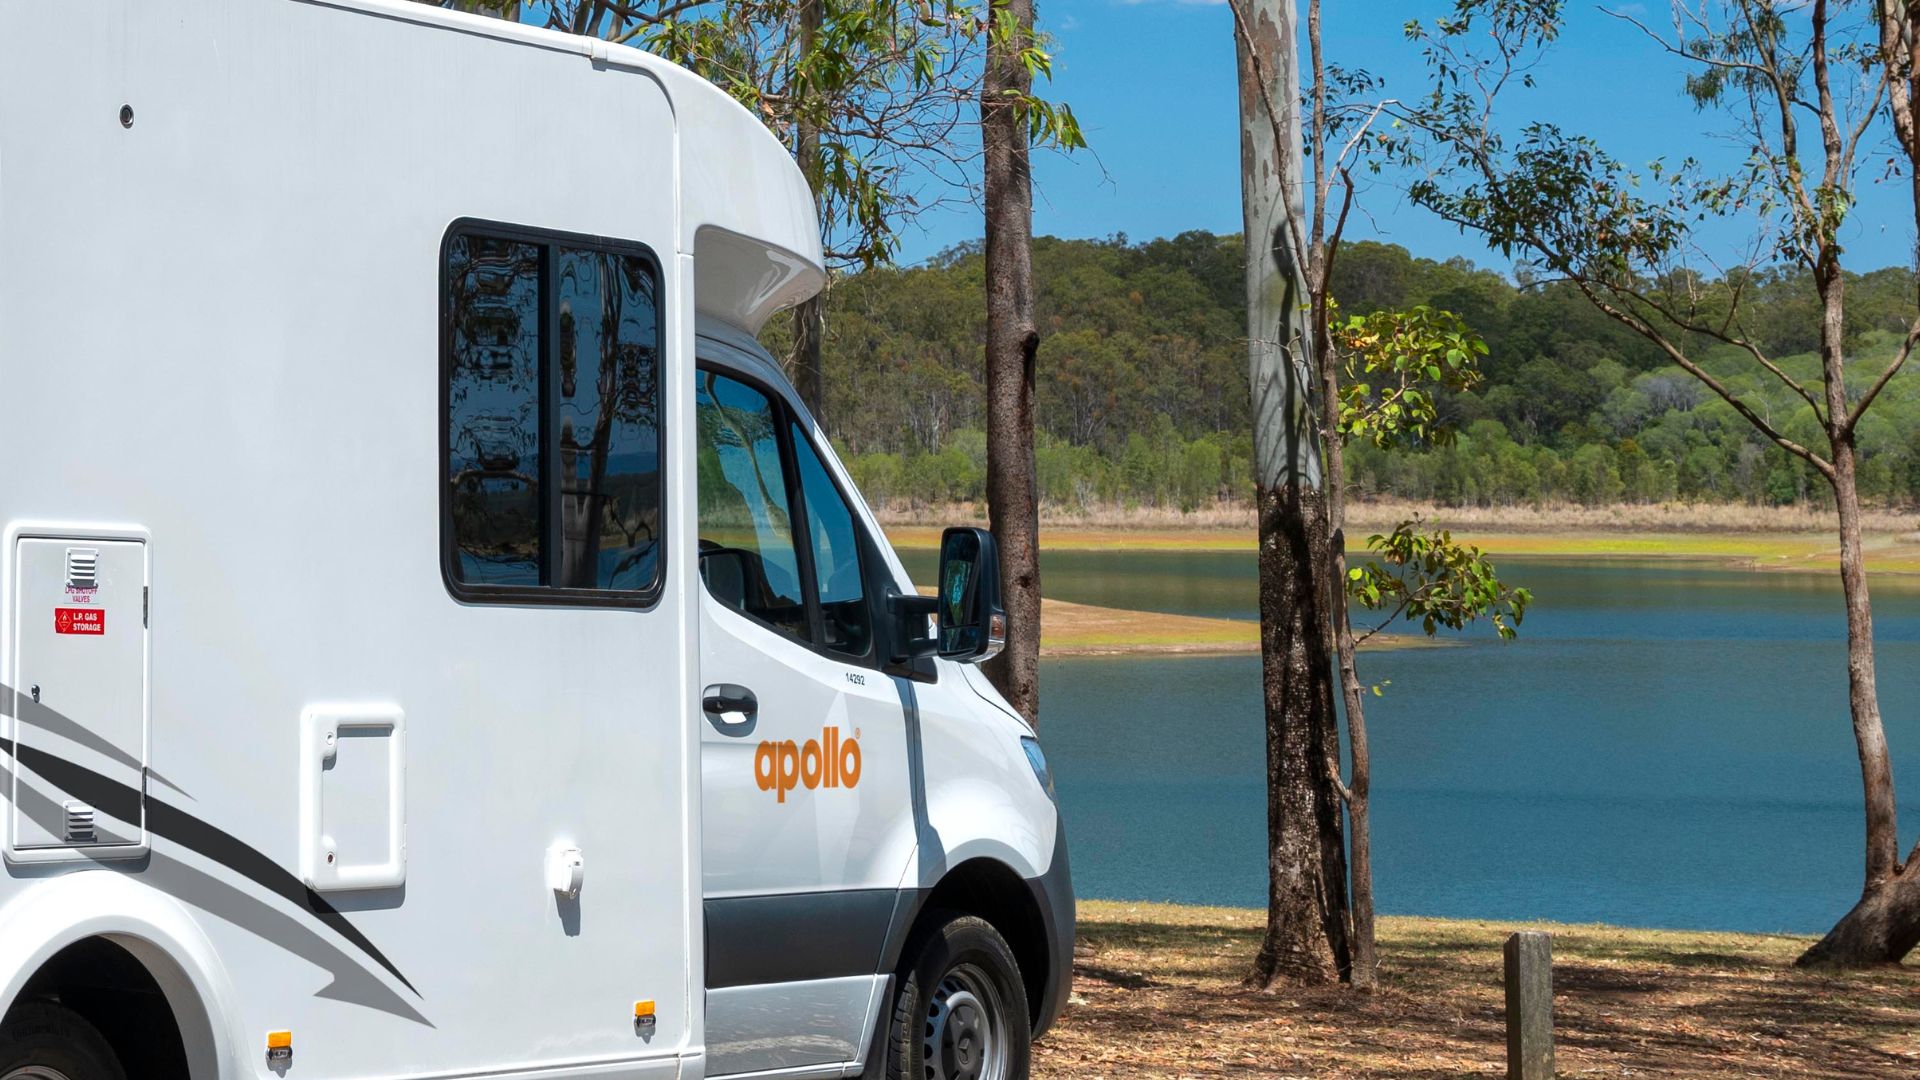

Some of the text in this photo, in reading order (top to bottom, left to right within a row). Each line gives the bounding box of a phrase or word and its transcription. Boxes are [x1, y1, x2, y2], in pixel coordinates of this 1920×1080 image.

[72, 595, 91, 603] VALVES
[73, 612, 98, 621] L.P. GAS
[73, 623, 102, 632] STORAGE
[845, 672, 865, 686] 14292
[754, 726, 862, 804] apollo
